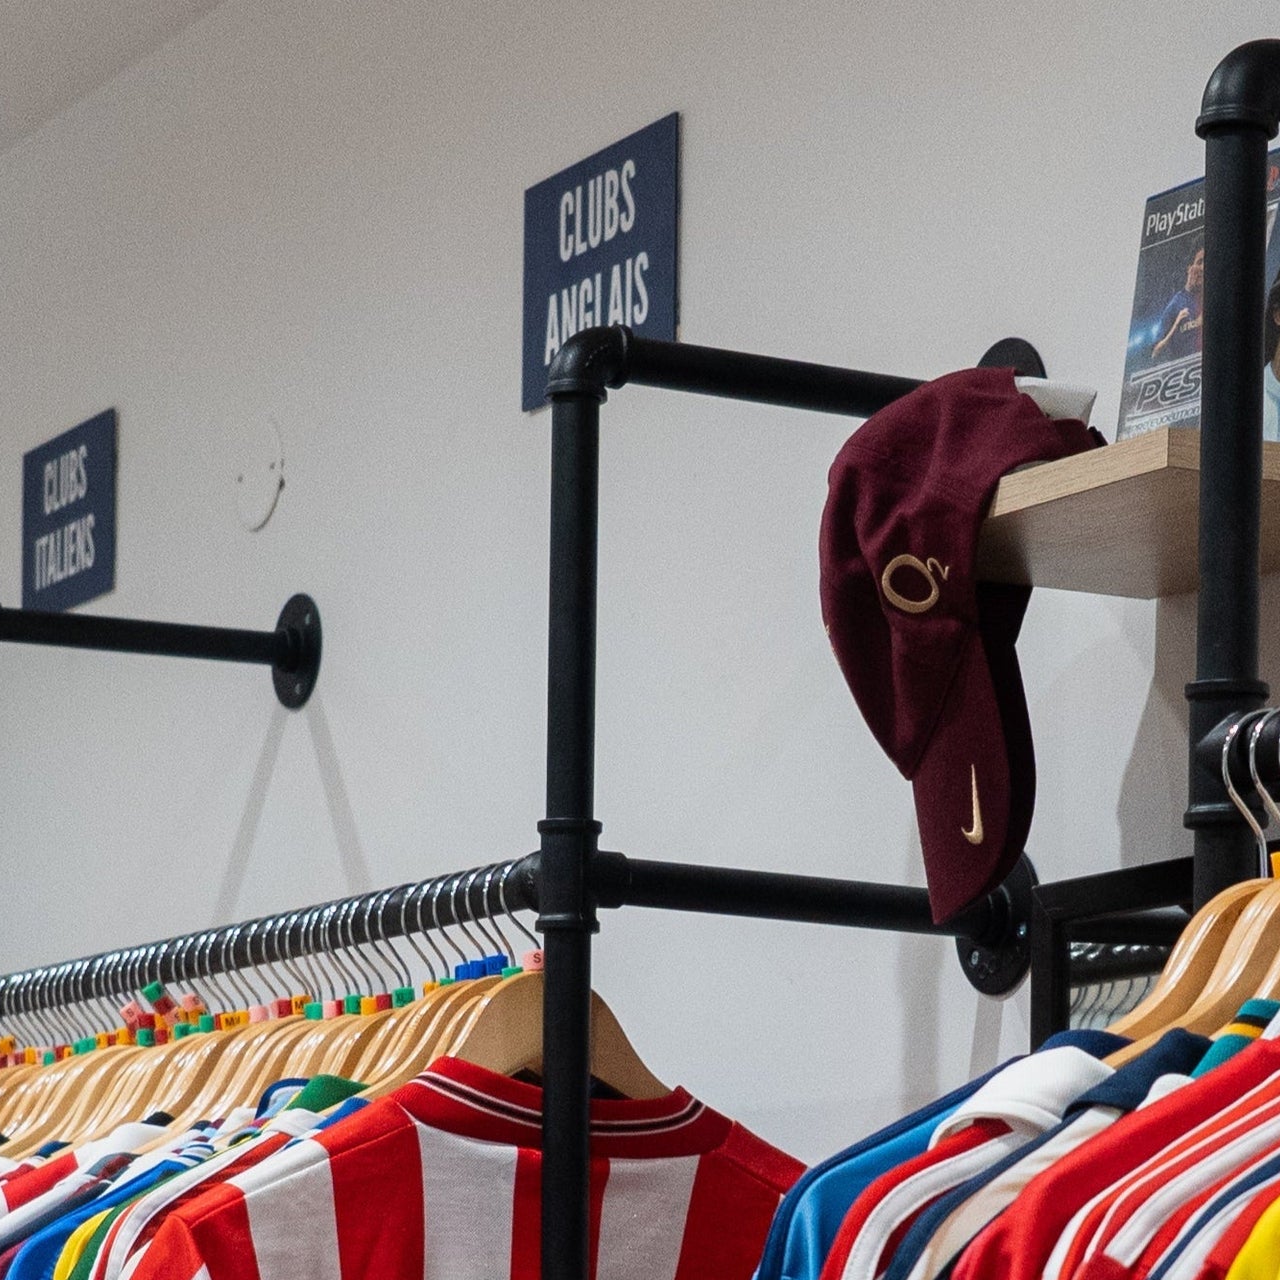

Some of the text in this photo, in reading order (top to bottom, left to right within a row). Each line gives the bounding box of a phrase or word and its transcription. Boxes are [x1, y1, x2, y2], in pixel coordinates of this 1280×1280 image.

[559, 159, 636, 263] CLUBS
[544, 251, 649, 367] ANGLAIS
[44, 444, 87, 515] CLUBS
[35, 512, 95, 592] ITALIENS
[533, 952, 541, 964] S
